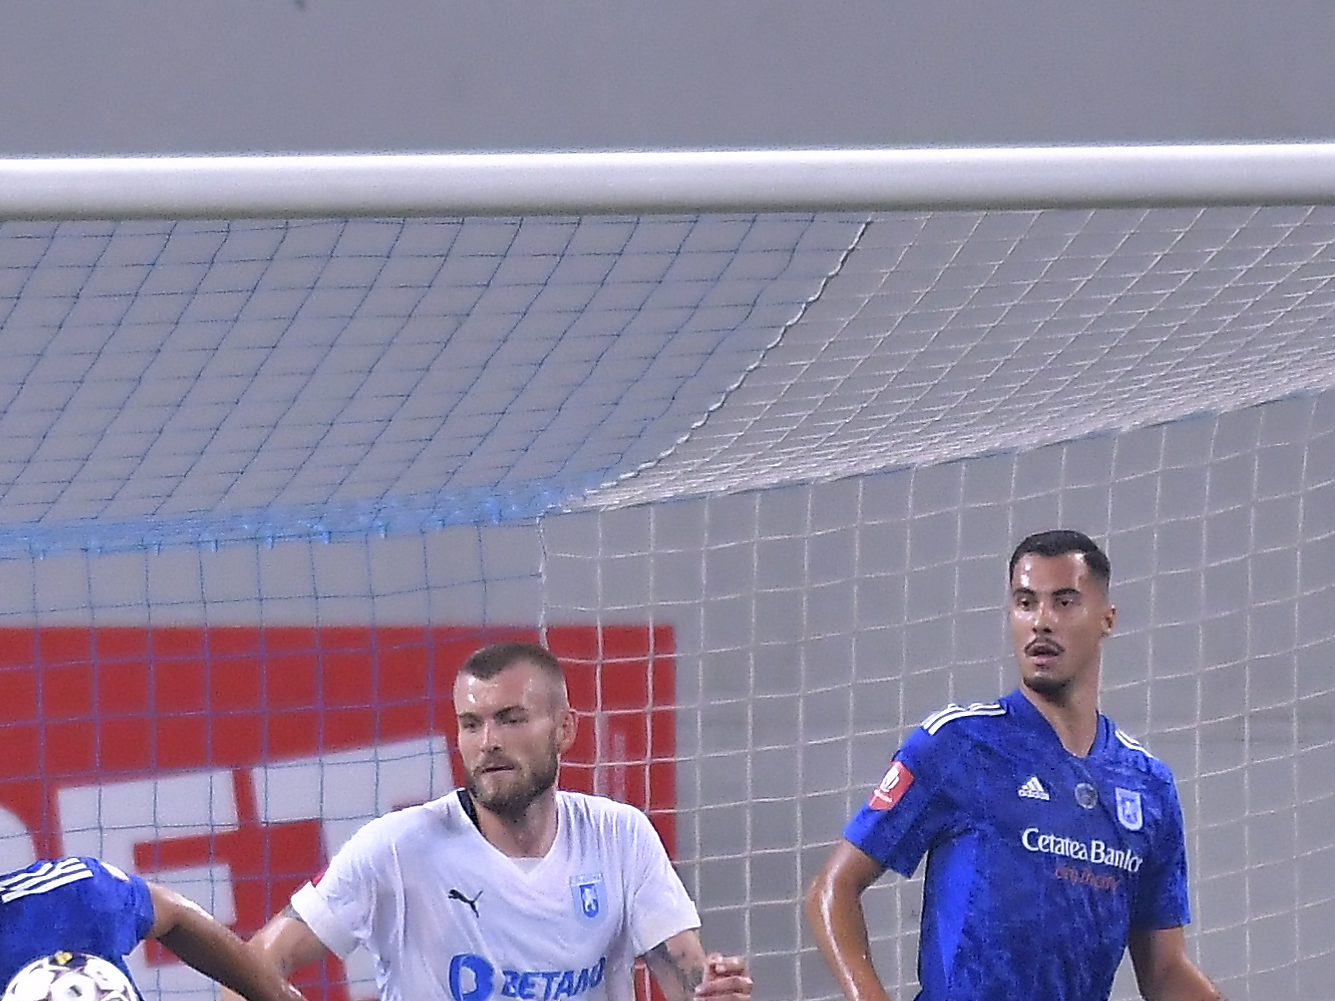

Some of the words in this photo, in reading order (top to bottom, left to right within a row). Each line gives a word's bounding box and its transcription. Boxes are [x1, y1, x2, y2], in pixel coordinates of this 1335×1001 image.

[1022, 828, 1088, 861] Cetatea
[1091, 839, 1143, 872] Banlor
[501, 956, 606, 1001] BETANO
